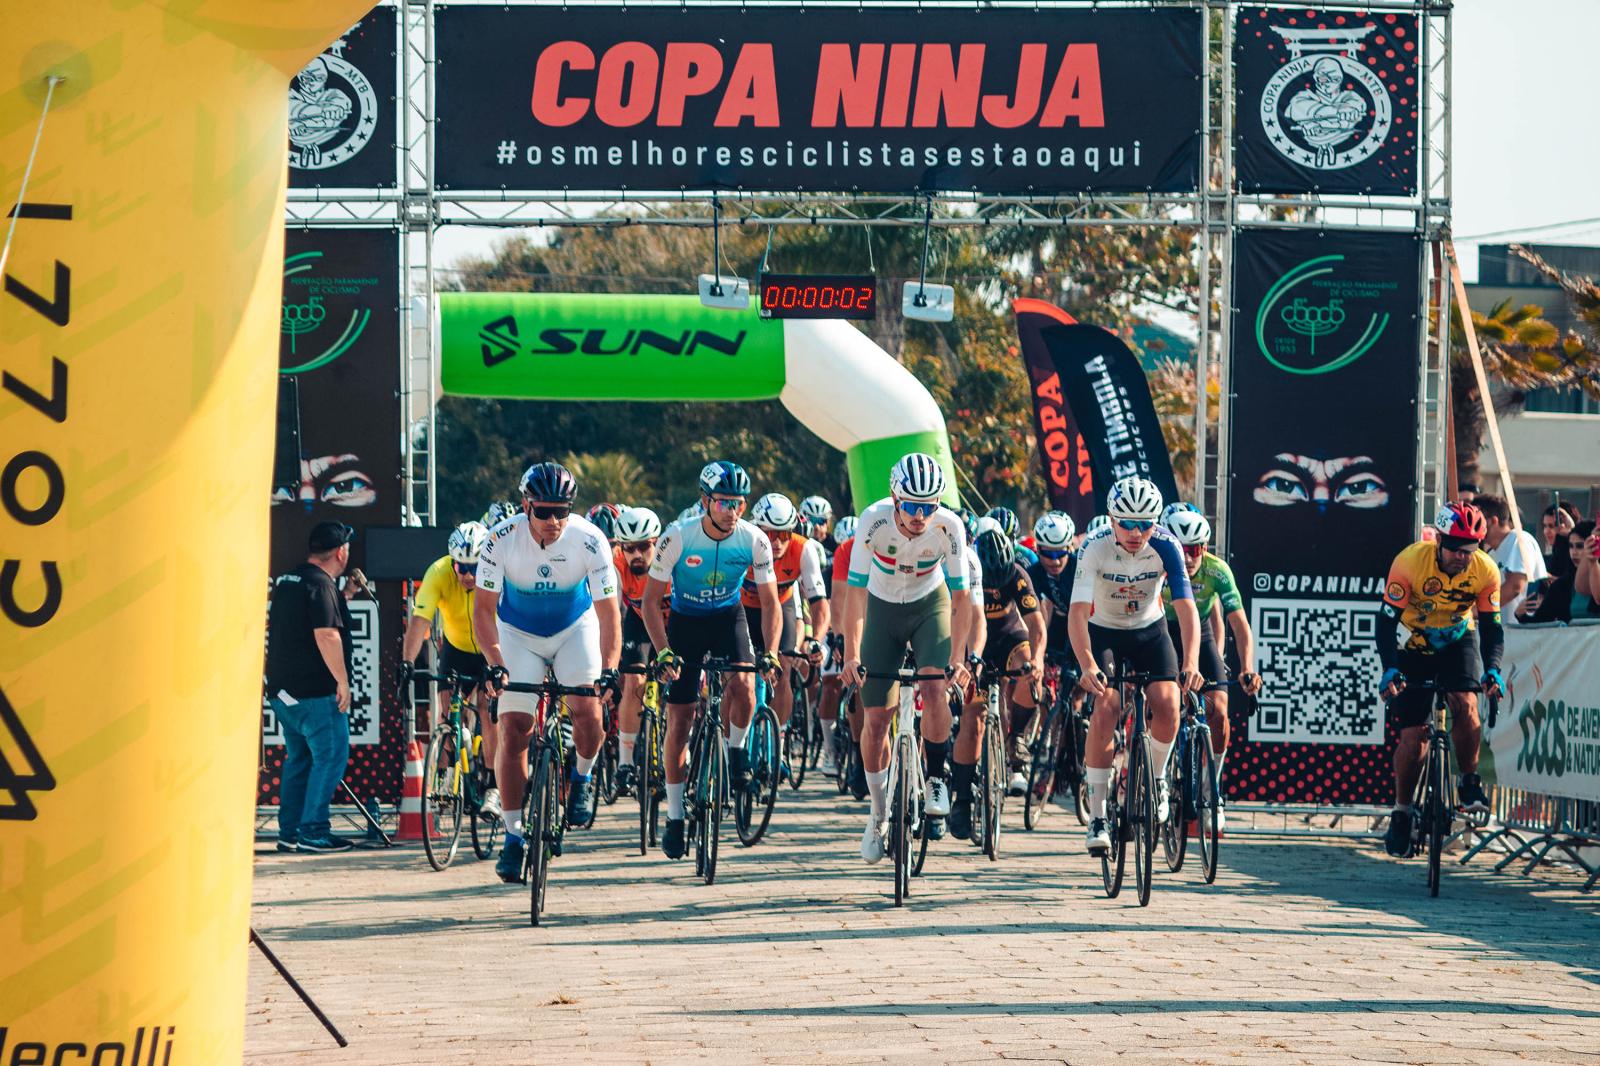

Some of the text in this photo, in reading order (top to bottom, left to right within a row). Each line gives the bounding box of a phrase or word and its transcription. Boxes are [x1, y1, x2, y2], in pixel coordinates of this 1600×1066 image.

[344, 69, 369, 94] MTB
[532, 40, 1105, 128] COPA NINJA
[1263, 60, 1383, 113] COPA NINJA MTB
[496, 140, 1142, 172] #osmelhoresciclistasestaoaqui
[763, 285, 873, 309] 00:00:02
[532, 328, 747, 356] SUNN
[1036, 371, 1069, 489] COPA
[655, 536, 671, 562] INICTA
[534, 581, 557, 591] DU
[1274, 575, 1386, 594] COPANINJA
[1567, 706, 1580, 737] DE
